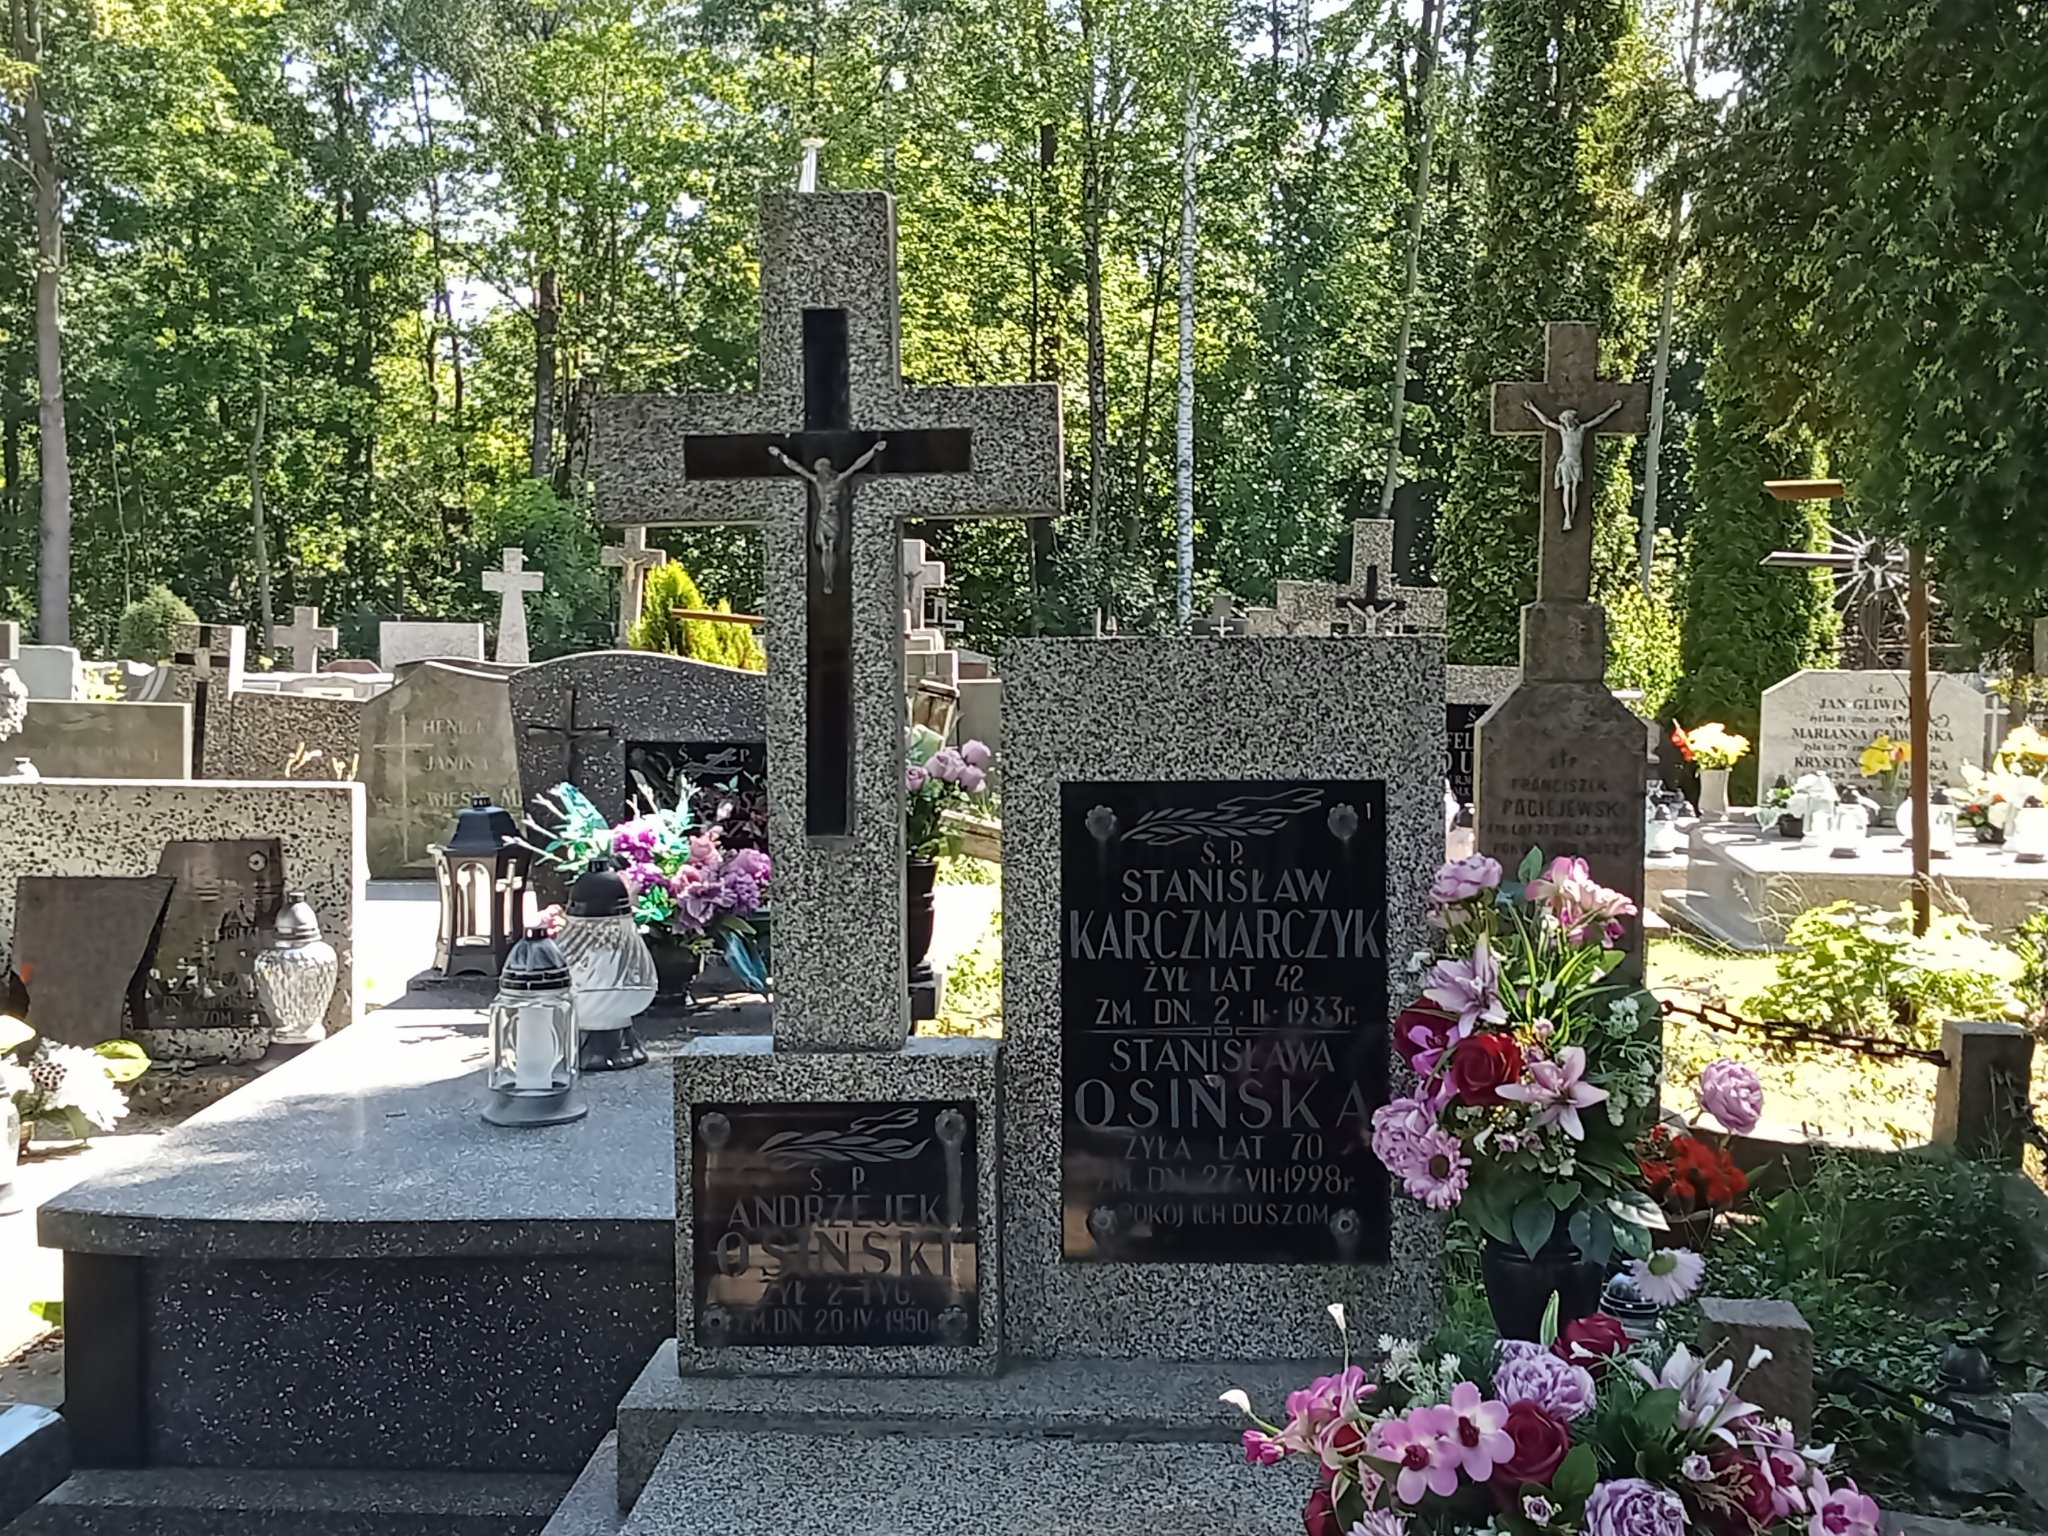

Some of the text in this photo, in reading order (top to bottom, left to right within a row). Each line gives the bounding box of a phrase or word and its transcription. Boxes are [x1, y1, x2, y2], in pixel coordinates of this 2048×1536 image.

[1818, 698, 1846, 710] JAN
[1791, 727, 1868, 740] MARIANNA
[1794, 756, 1862, 768] KRYSTYN
[1121, 868, 1331, 903] STANISŁAW
[1069, 908, 1382, 961] KARCZMARCZYK
[1143, 960, 1304, 992] ŻYŁ LAT 42
[1095, 998, 1137, 1026] ZM.
[1110, 1038, 1335, 1073] STANISŁAWA
[1219, 1134, 1266, 1160] LAT
[1290, 1133, 1323, 1160] 70
[1192, 1203, 1226, 1225] ICH
[1232, 1202, 1330, 1226] DUSZOM
[827, 1279, 843, 1306] 2
